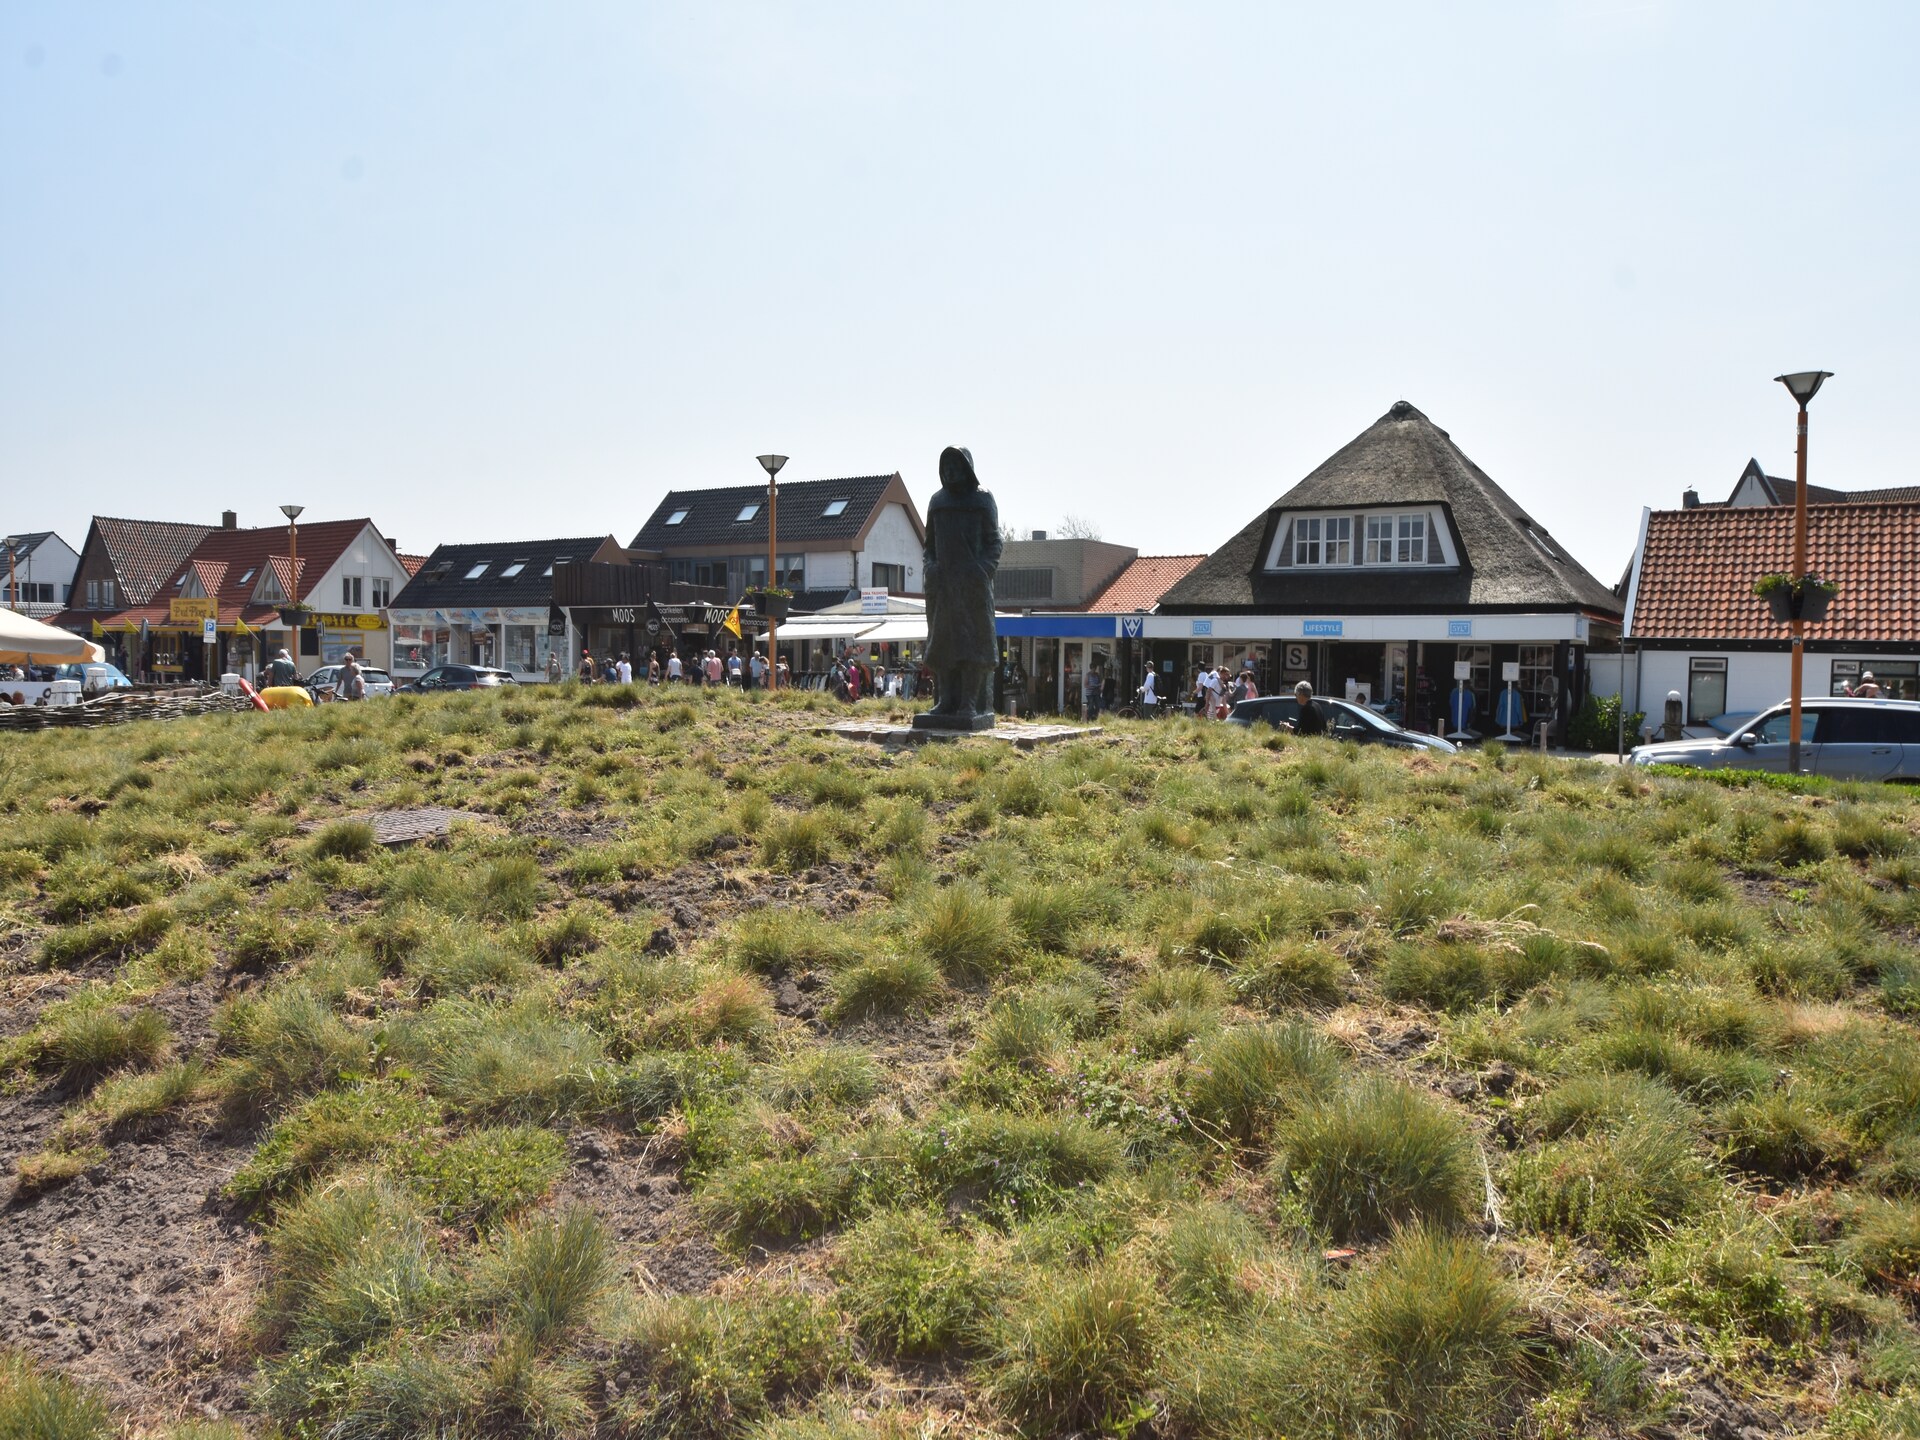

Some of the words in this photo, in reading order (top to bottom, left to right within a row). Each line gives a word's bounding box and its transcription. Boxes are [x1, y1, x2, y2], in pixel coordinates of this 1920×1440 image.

[612, 608, 636, 623] MOOS
[703, 607, 730, 624] MOOS
[1123, 618, 1142, 638] VVV
[1305, 624, 1341, 632] LIFESTYLE
